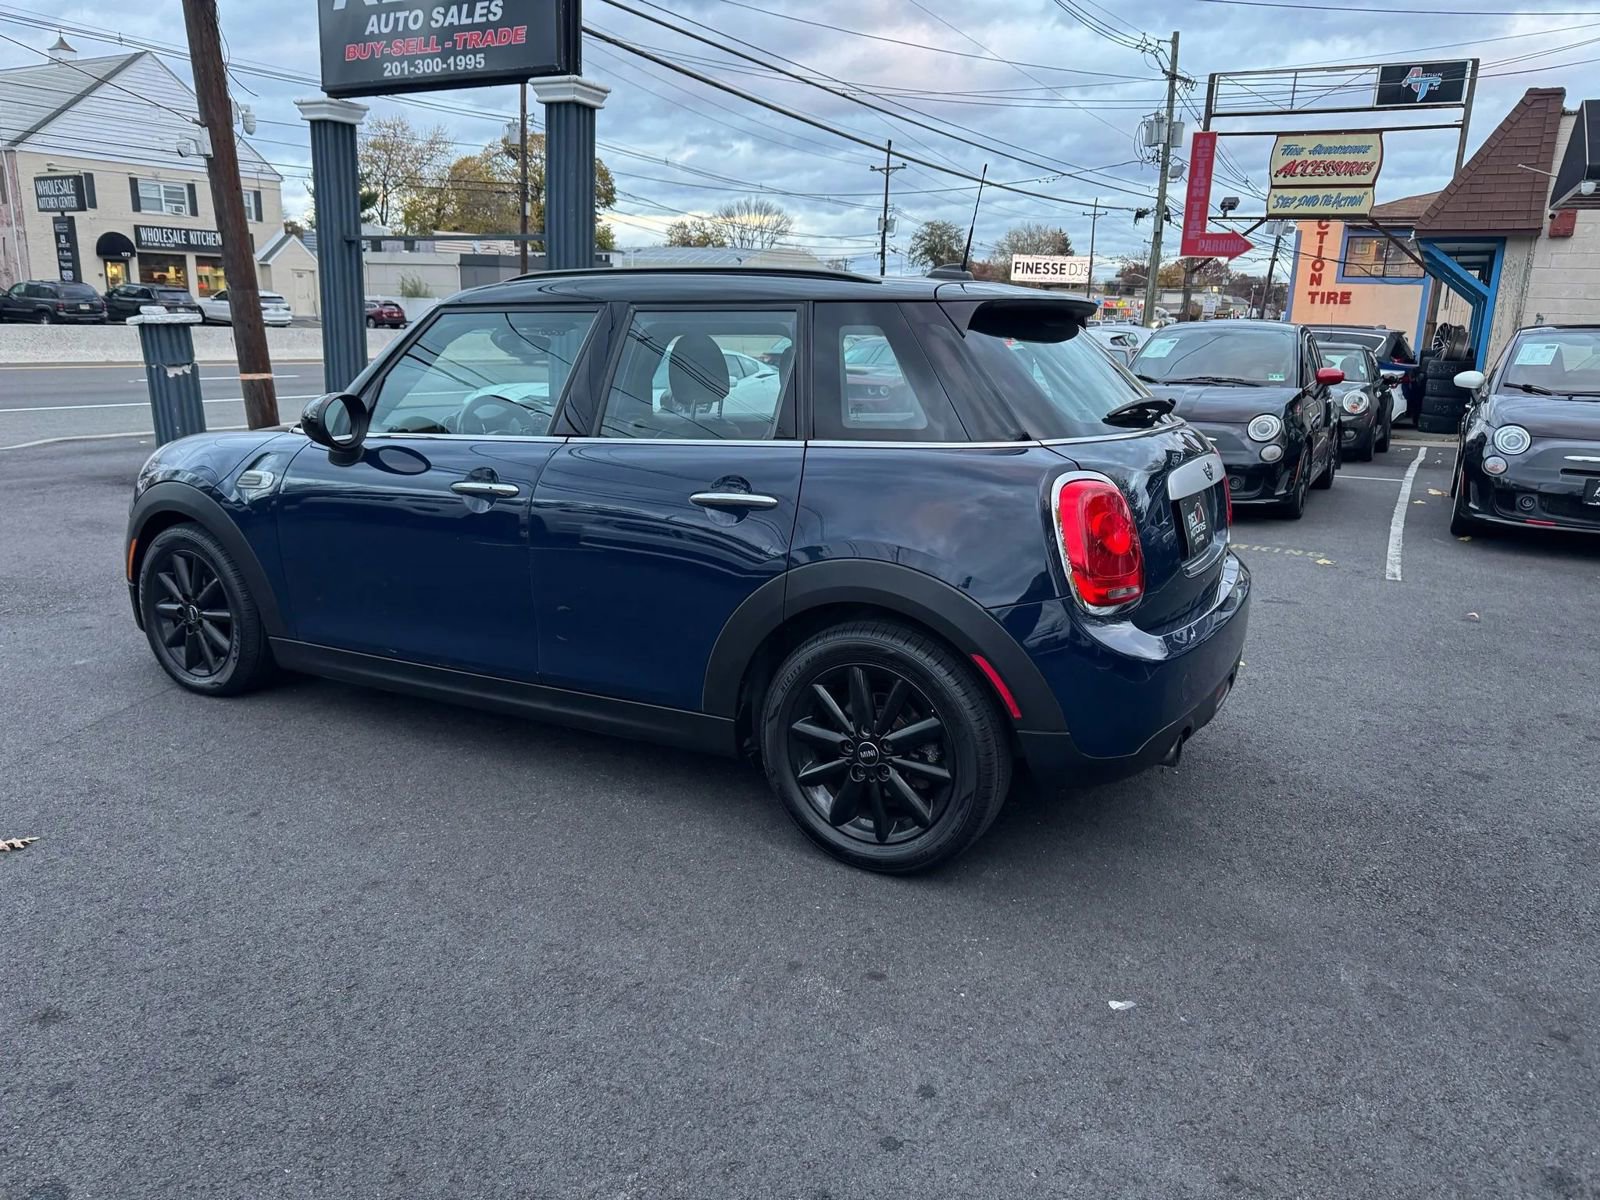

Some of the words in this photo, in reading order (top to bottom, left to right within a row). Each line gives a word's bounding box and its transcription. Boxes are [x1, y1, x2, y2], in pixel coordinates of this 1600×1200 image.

[365, 9, 424, 35] AUTO
[430, 2, 503, 28] SALES
[383, 53, 486, 77] 201-300-1995
[1274, 159, 1376, 178] ACCESSORIES
[35, 178, 75, 196] WHOLESALE
[38, 196, 59, 209] KITCHEN
[60, 196, 78, 208] CENTER
[140, 227, 187, 245] WHOLESALE
[189, 231, 223, 246] KITCHEN
[1197, 239, 1246, 252] PARKING
[1014, 261, 1067, 275] FINESSE
[1308, 291, 1352, 305] TIRE
[860, 750, 876, 758] MINI
